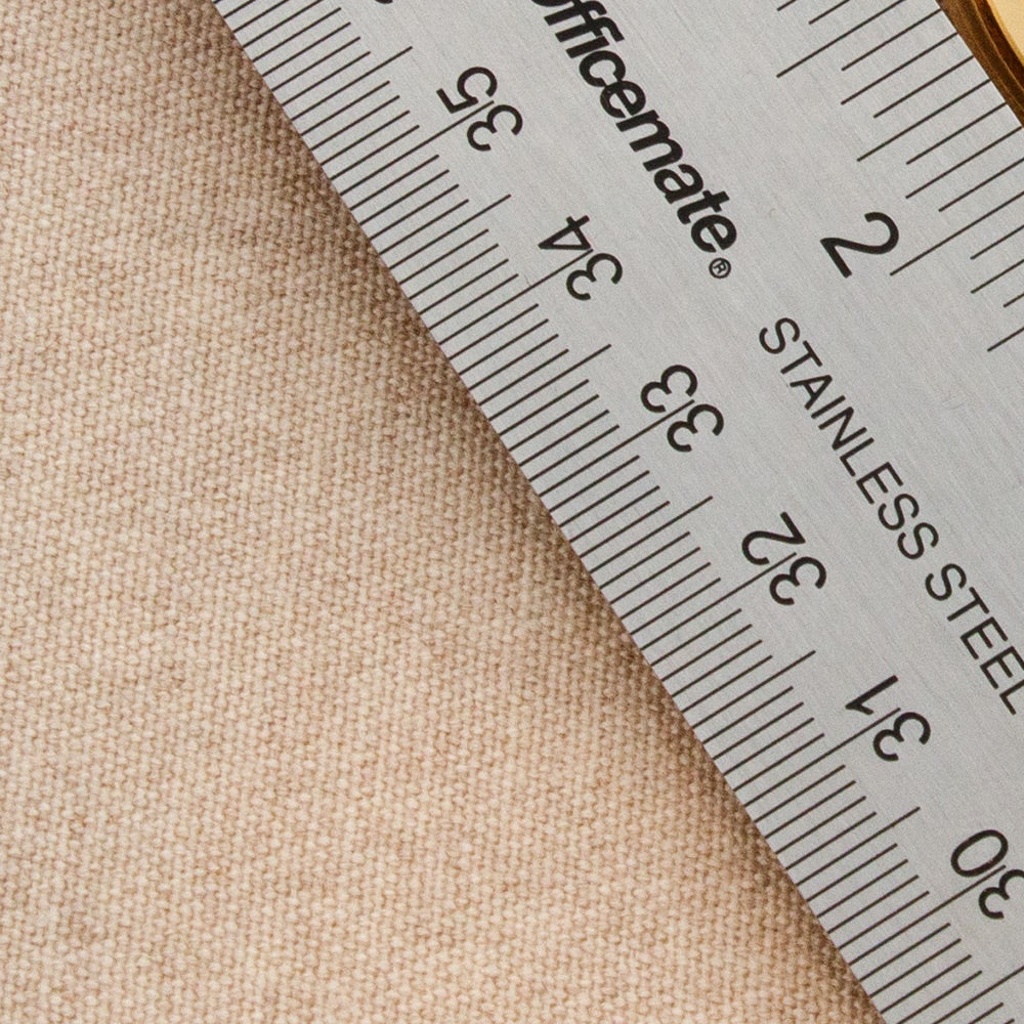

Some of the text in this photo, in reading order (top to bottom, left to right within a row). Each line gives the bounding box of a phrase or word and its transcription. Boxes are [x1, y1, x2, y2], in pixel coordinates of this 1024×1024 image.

[436, 66, 524, 152] 35
[538, 215, 623, 301] 34
[820, 211, 900, 279] 2
[640, 364, 725, 453] 33
[759, 317, 939, 561] STAINLESS
[741, 511, 827, 606] 32
[845, 674, 932, 762] 31
